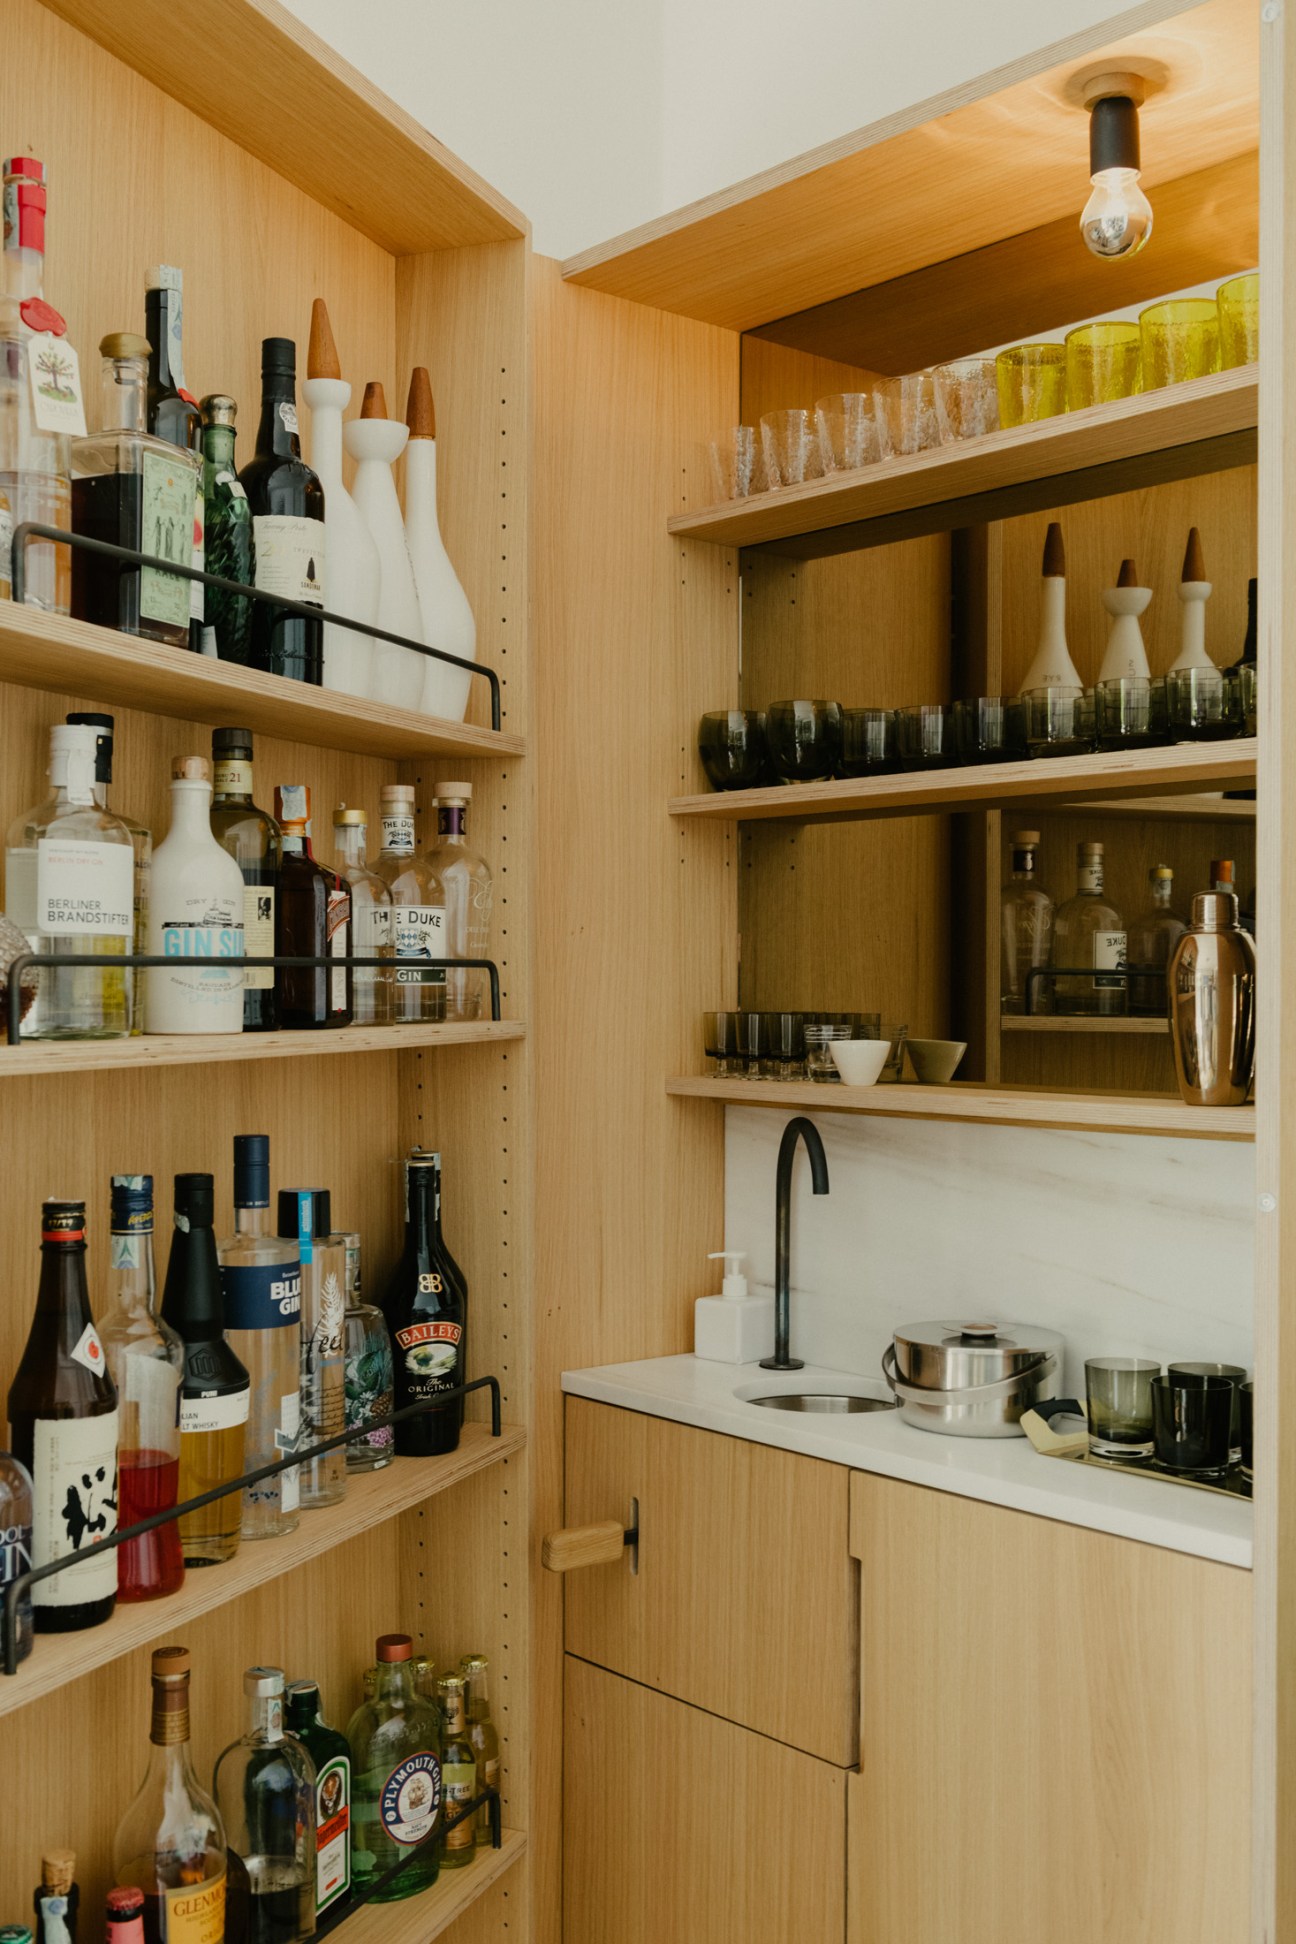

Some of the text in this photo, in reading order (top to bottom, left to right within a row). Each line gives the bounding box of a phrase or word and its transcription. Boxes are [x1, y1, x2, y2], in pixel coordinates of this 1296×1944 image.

[229, 773, 241, 783] 21
[383, 821, 397, 829] THE
[47, 898, 102, 910] BERLINER
[185, 898, 206, 906] DRY
[47, 911, 129, 926] BRANDSTIFTER
[371, 910, 441, 928] THE DUKE
[163, 929, 213, 957] GIN
[397, 970, 422, 982] GIN
[400, 1325, 460, 1345] BAILEYS
[407, 1382, 455, 1393] ORIGINAL
[426, 1378, 442, 1386] The
[192, 1421, 219, 1430] WHISKY
[384, 1756, 441, 1808] PLYMOUTH GIN
